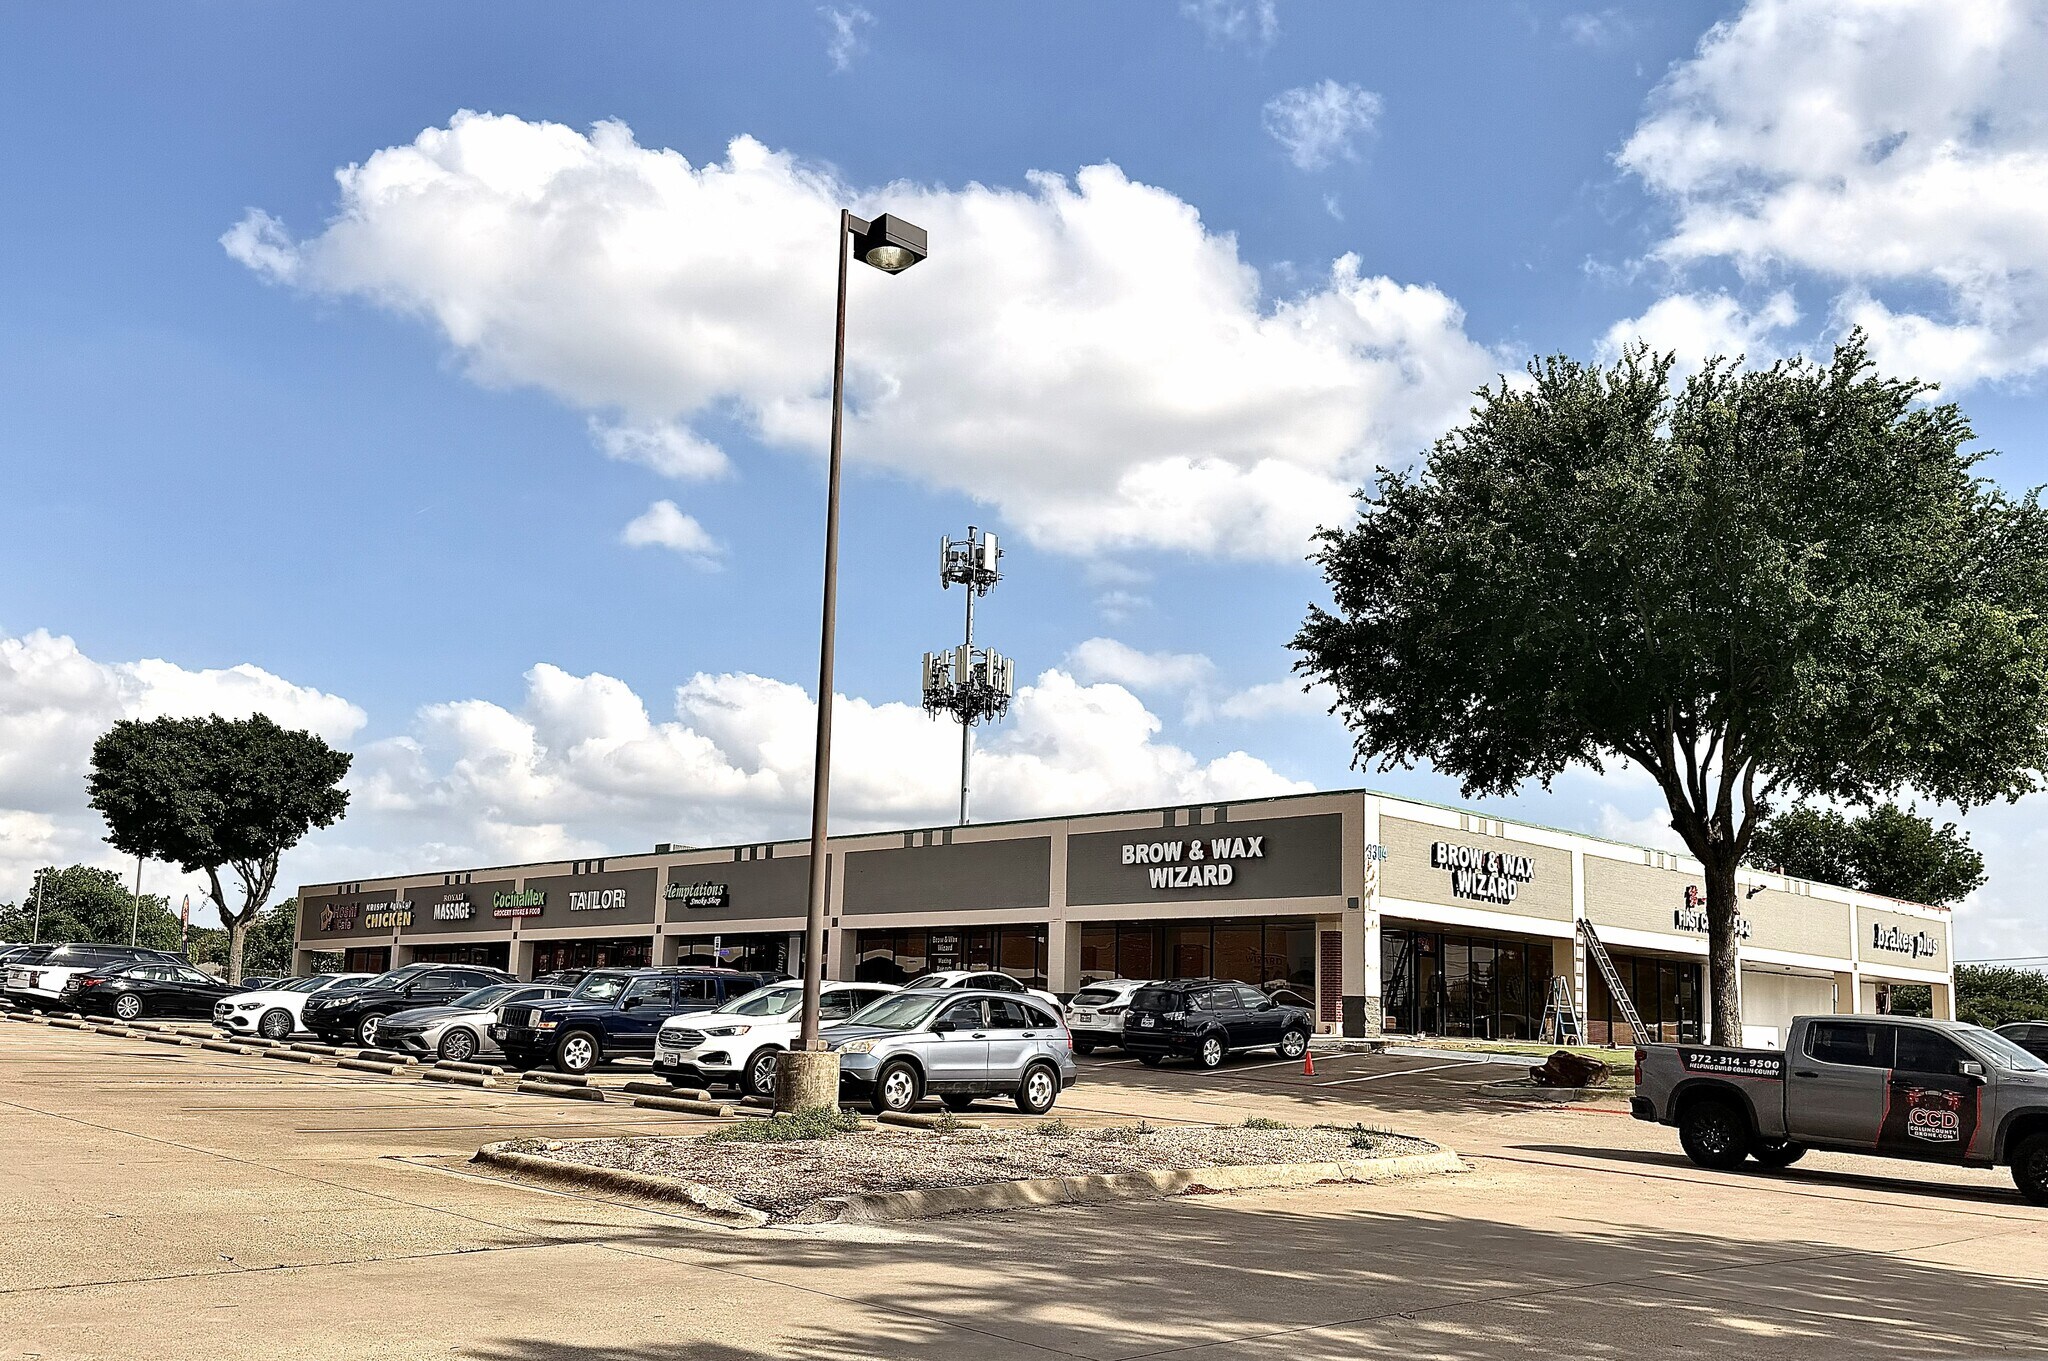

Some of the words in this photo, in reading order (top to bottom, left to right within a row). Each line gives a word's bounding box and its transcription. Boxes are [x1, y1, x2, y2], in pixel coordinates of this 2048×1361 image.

[1121, 840, 1183, 864] BROW
[1188, 839, 1205, 861] &
[1211, 836, 1264, 859] WAX
[1433, 841, 1484, 870] BROW
[1486, 850, 1499, 874] &
[1501, 853, 1536, 881] WAX
[1149, 864, 1234, 889] WIZARD
[1454, 868, 1519, 902] WIZARD
[493, 888, 545, 908] CocinaMex
[569, 888, 626, 911] TAILOR
[663, 881, 724, 903] Hemptations
[365, 902, 388, 912] KRISPY
[433, 902, 470, 920] MASSAGE
[365, 911, 412, 929] CHICKEN
[1675, 909, 1701, 930] FIRST
[1875, 923, 1914, 951] brakes
[1914, 931, 1940, 957] plus
[1689, 1062, 1714, 1070] HELPING
[1732, 1066, 1754, 1074] COLLIN
[1754, 1068, 1780, 1076] COUNTY
[1910, 1108, 1959, 1128] CCD
